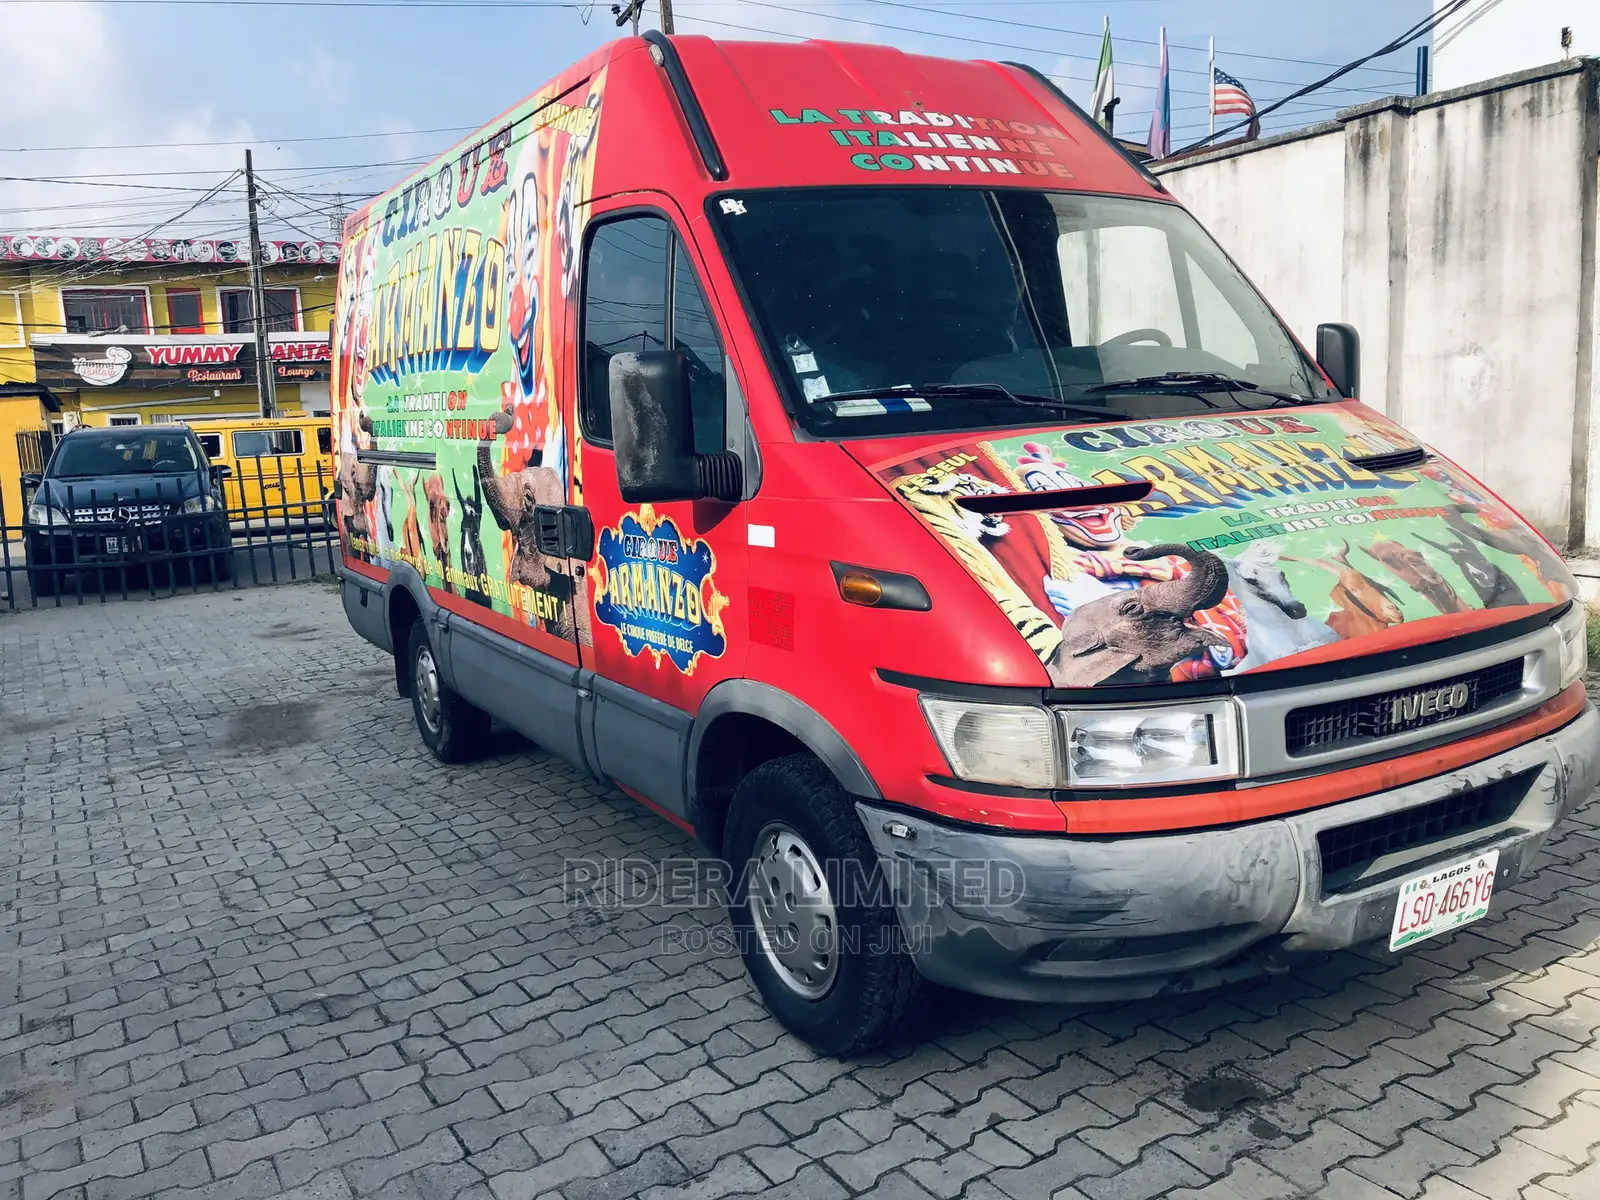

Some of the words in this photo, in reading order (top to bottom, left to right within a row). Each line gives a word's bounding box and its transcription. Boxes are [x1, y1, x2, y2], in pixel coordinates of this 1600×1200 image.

[768, 108, 834, 125] LA
[836, 108, 1069, 141] TRADITION
[829, 130, 1056, 156] ITALIENNE
[850, 152, 1075, 179] CONTINUE
[382, 121, 513, 247] CIRQUE
[368, 228, 505, 374] ARMANZO
[144, 344, 244, 365] YUMMY
[187, 368, 242, 382] Restaurant
[278, 366, 315, 378] Lounge
[387, 395, 399, 413] LA
[404, 390, 467, 412] TRADITION
[371, 419, 424, 438] ITALIENNE
[427, 419, 497, 441] CONTINUE
[1061, 415, 1322, 452] CIRQUE
[898, 474, 930, 495] LE
[926, 453, 979, 478] SEUL
[1220, 511, 1264, 527] LA
[1261, 495, 1398, 519] TRADITION
[624, 534, 678, 564] CIRQUE
[1186, 517, 1332, 552] ITALIENNE
[480, 572, 558, 622] GRATUITEMENT
[609, 562, 701, 625] ARMANZO
[1392, 683, 1469, 724] IVECO
[1432, 864, 1472, 884] LAGOS
